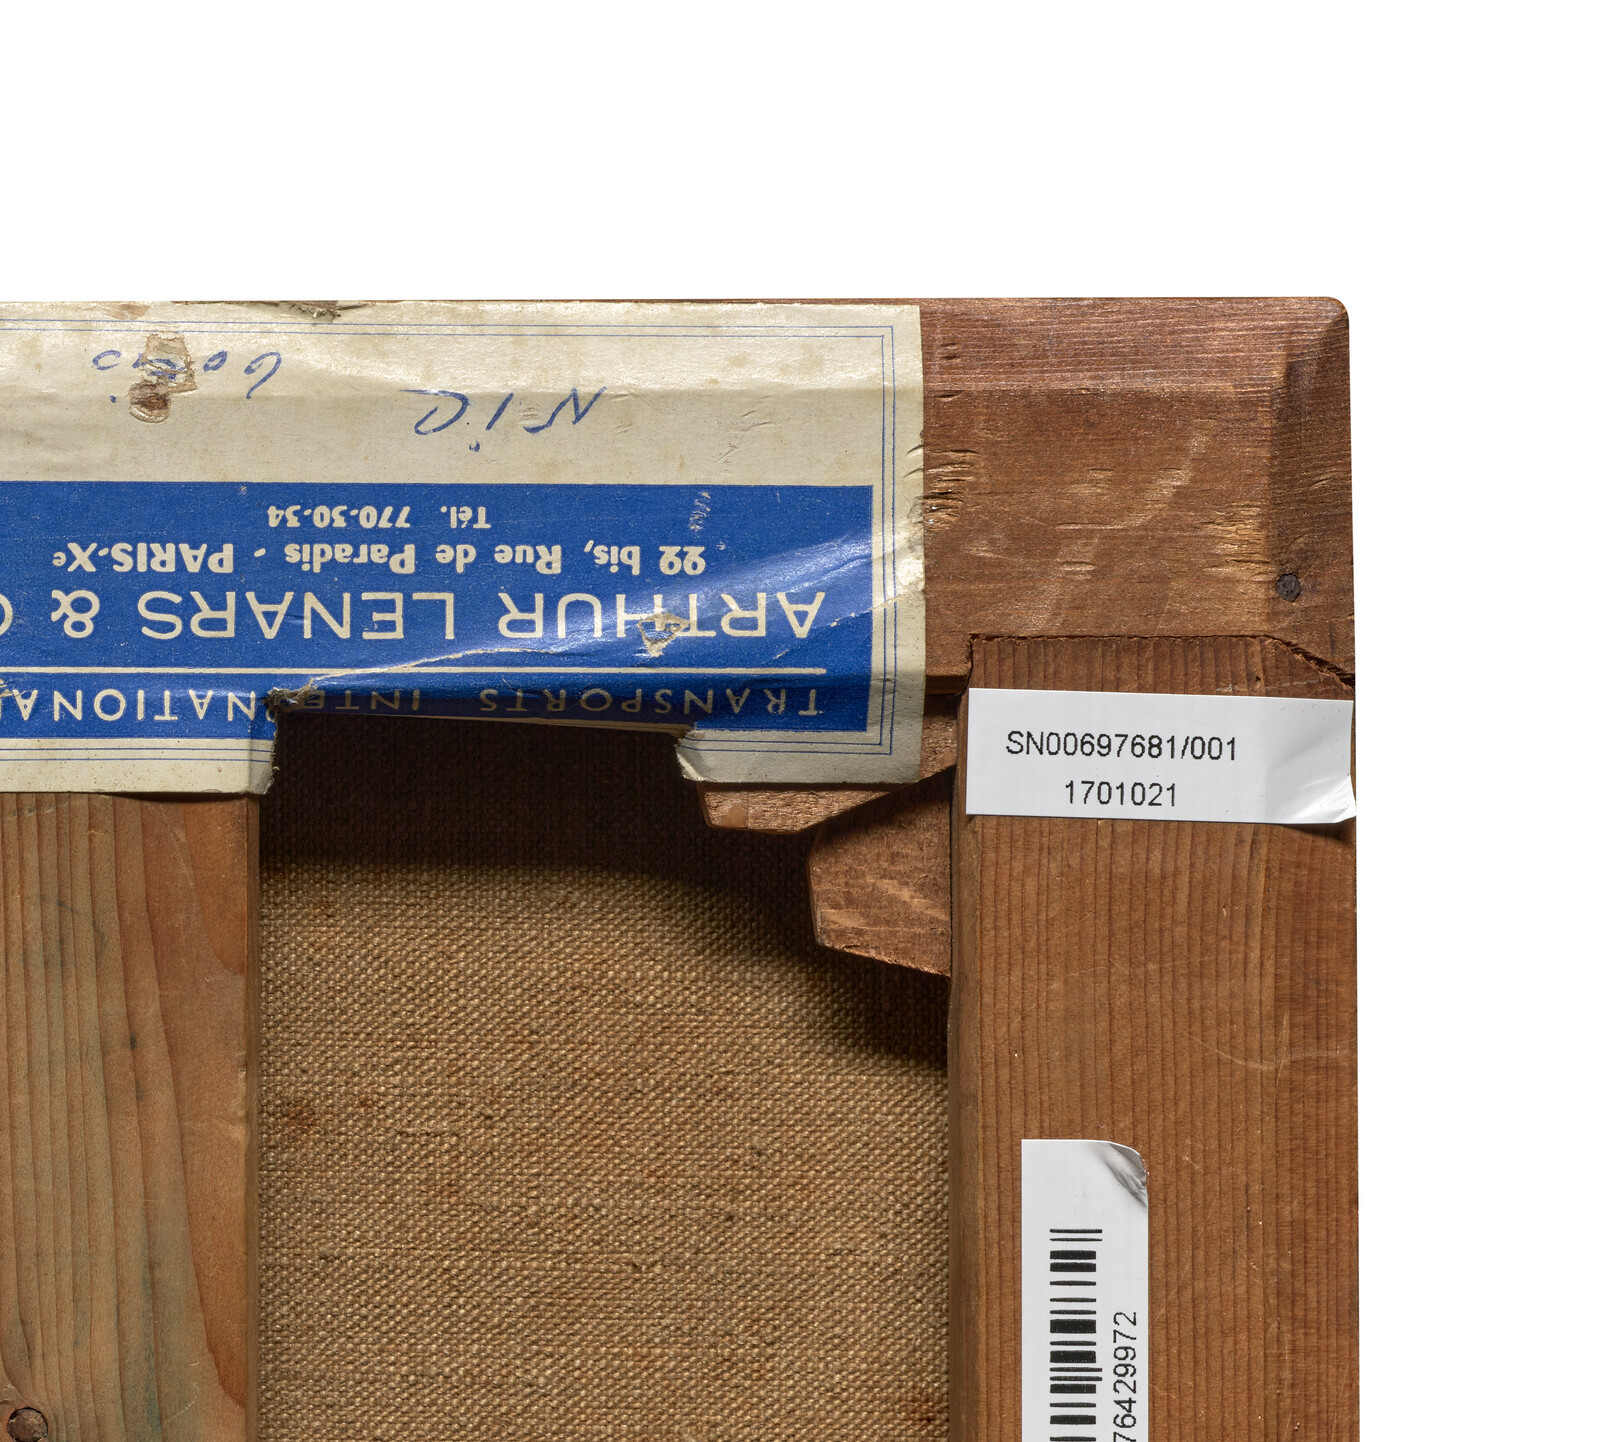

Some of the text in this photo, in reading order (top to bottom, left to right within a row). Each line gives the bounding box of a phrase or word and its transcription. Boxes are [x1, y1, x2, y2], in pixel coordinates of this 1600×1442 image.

[266, 505, 492, 529] Tél. 770-30-34
[283, 543, 416, 575] Paradis
[434, 543, 477, 574] de
[493, 544, 563, 575] Rue
[583, 539, 641, 576] bis,
[658, 545, 707, 576] 22
[50, 589, 100, 639] &
[137, 590, 455, 641] LENARS
[497, 591, 826, 639] ARTHUR
[478, 688, 824, 717] TRANSPORTS
[1004, 730, 1237, 761] SN00697681/001
[1064, 779, 1177, 807] 1701021
